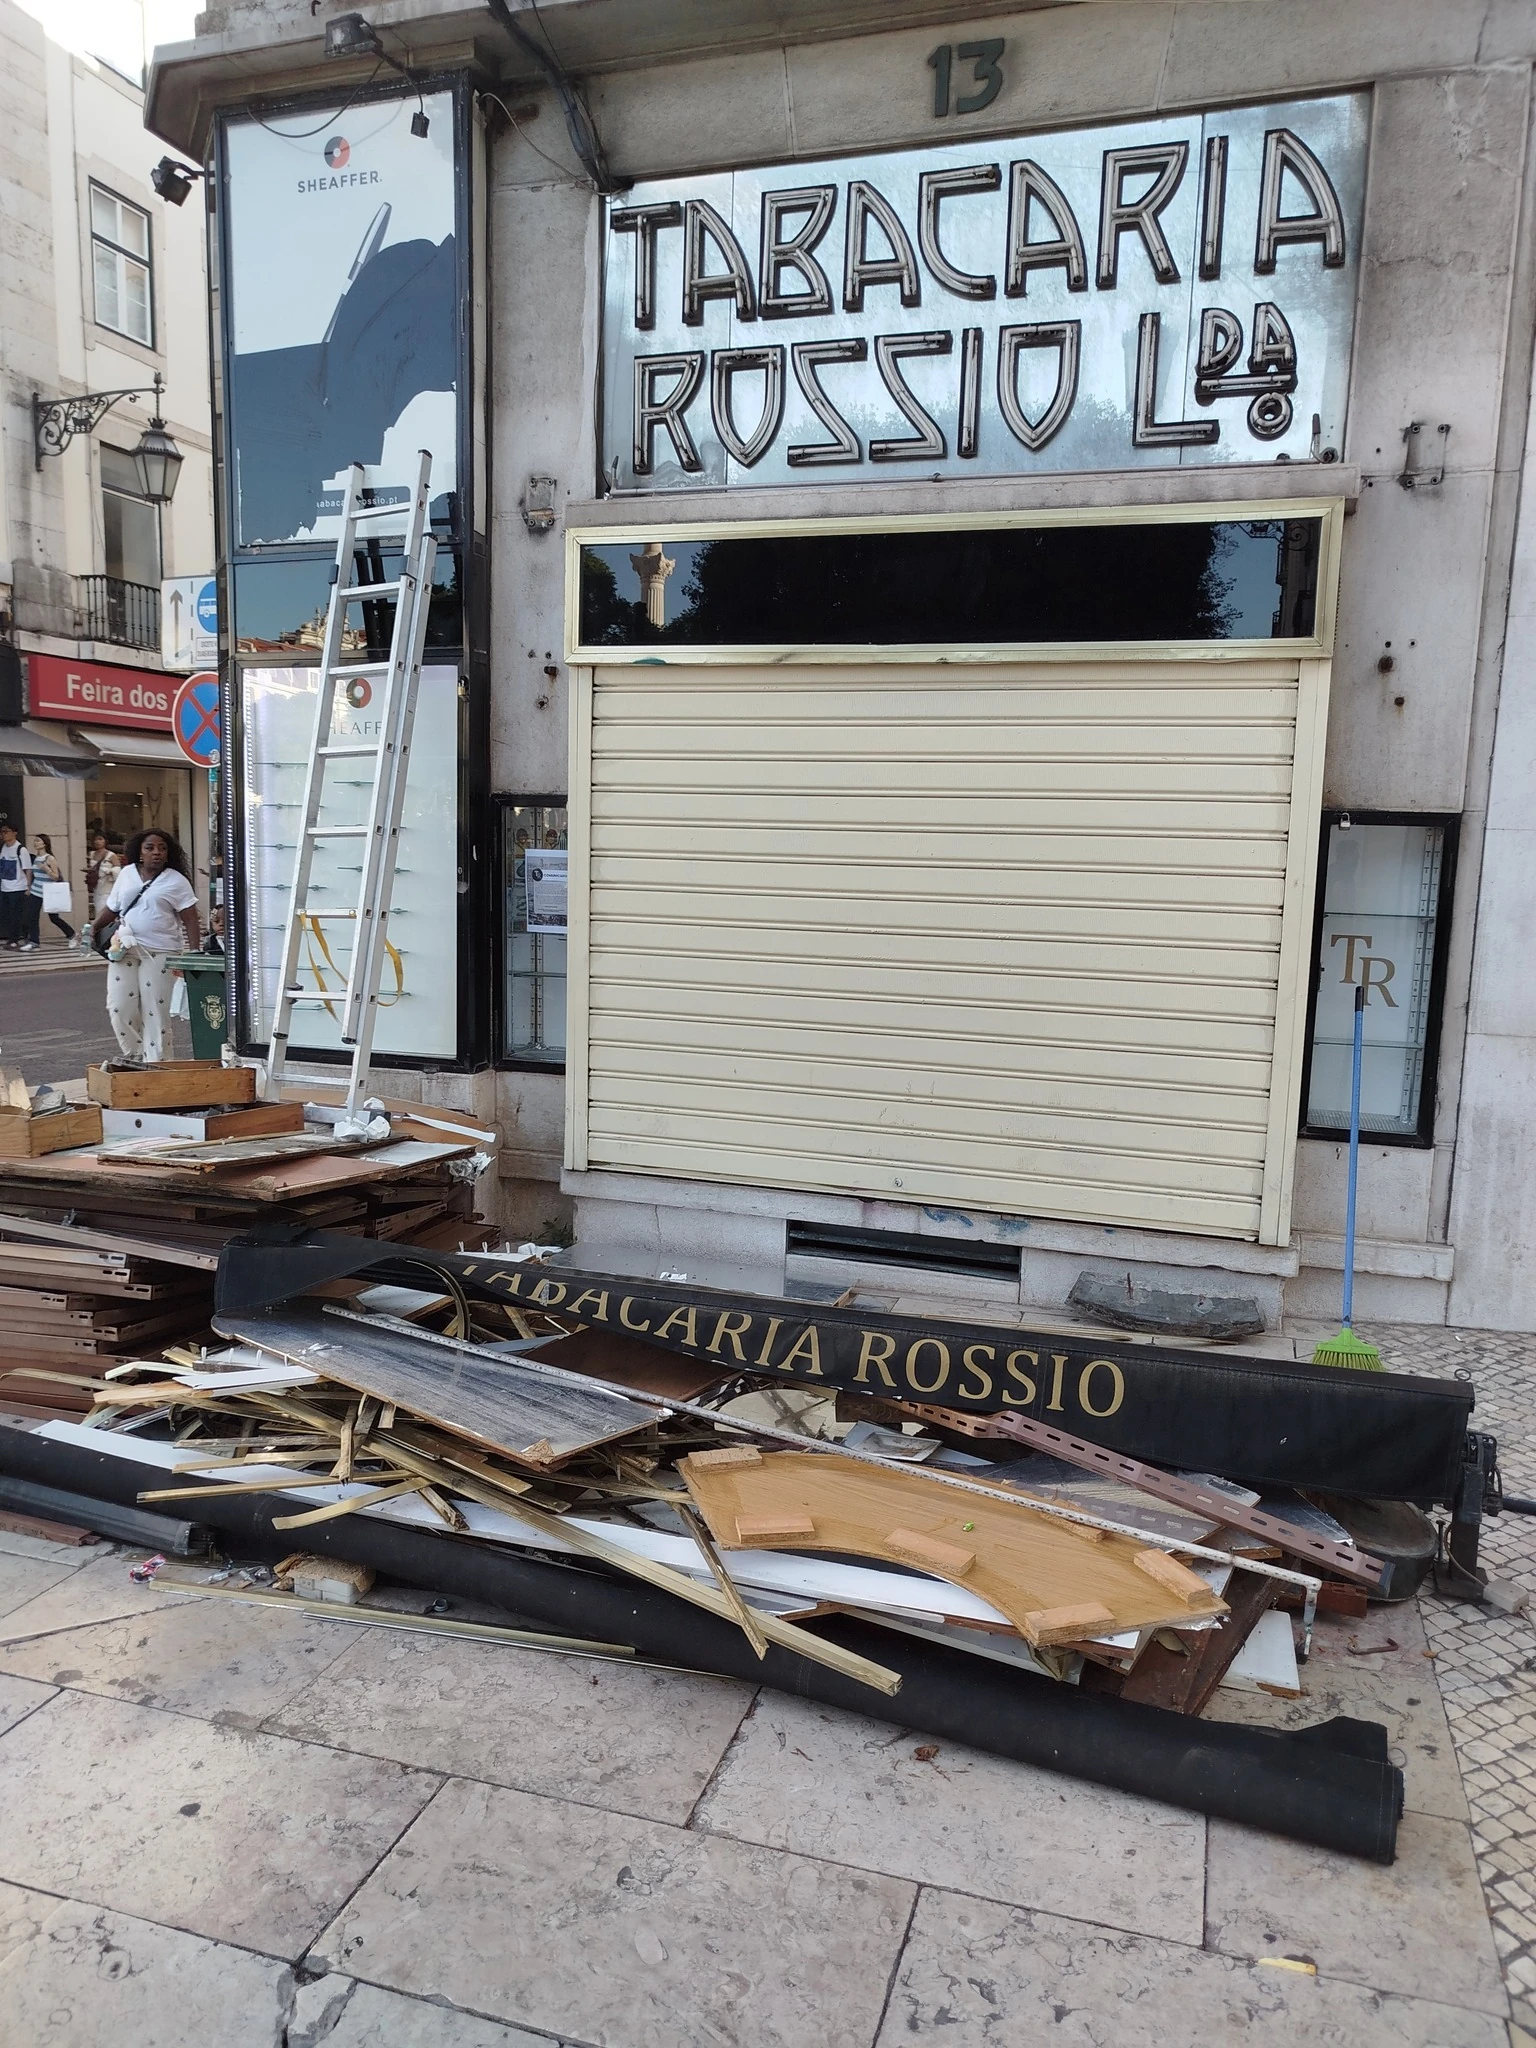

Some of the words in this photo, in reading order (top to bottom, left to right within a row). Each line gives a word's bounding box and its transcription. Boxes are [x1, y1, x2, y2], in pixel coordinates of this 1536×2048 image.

[928, 37, 1005, 118] 13
[297, 170, 380, 194] SHEAFFER
[609, 128, 1346, 330] TABACARIA
[631, 318, 1081, 475] ROSSIO
[66, 673, 124, 706] Feira
[128, 684, 168, 711] dos
[329, 721, 383, 735] HEAFF
[854, 1329, 1126, 1418] ROSSIO
